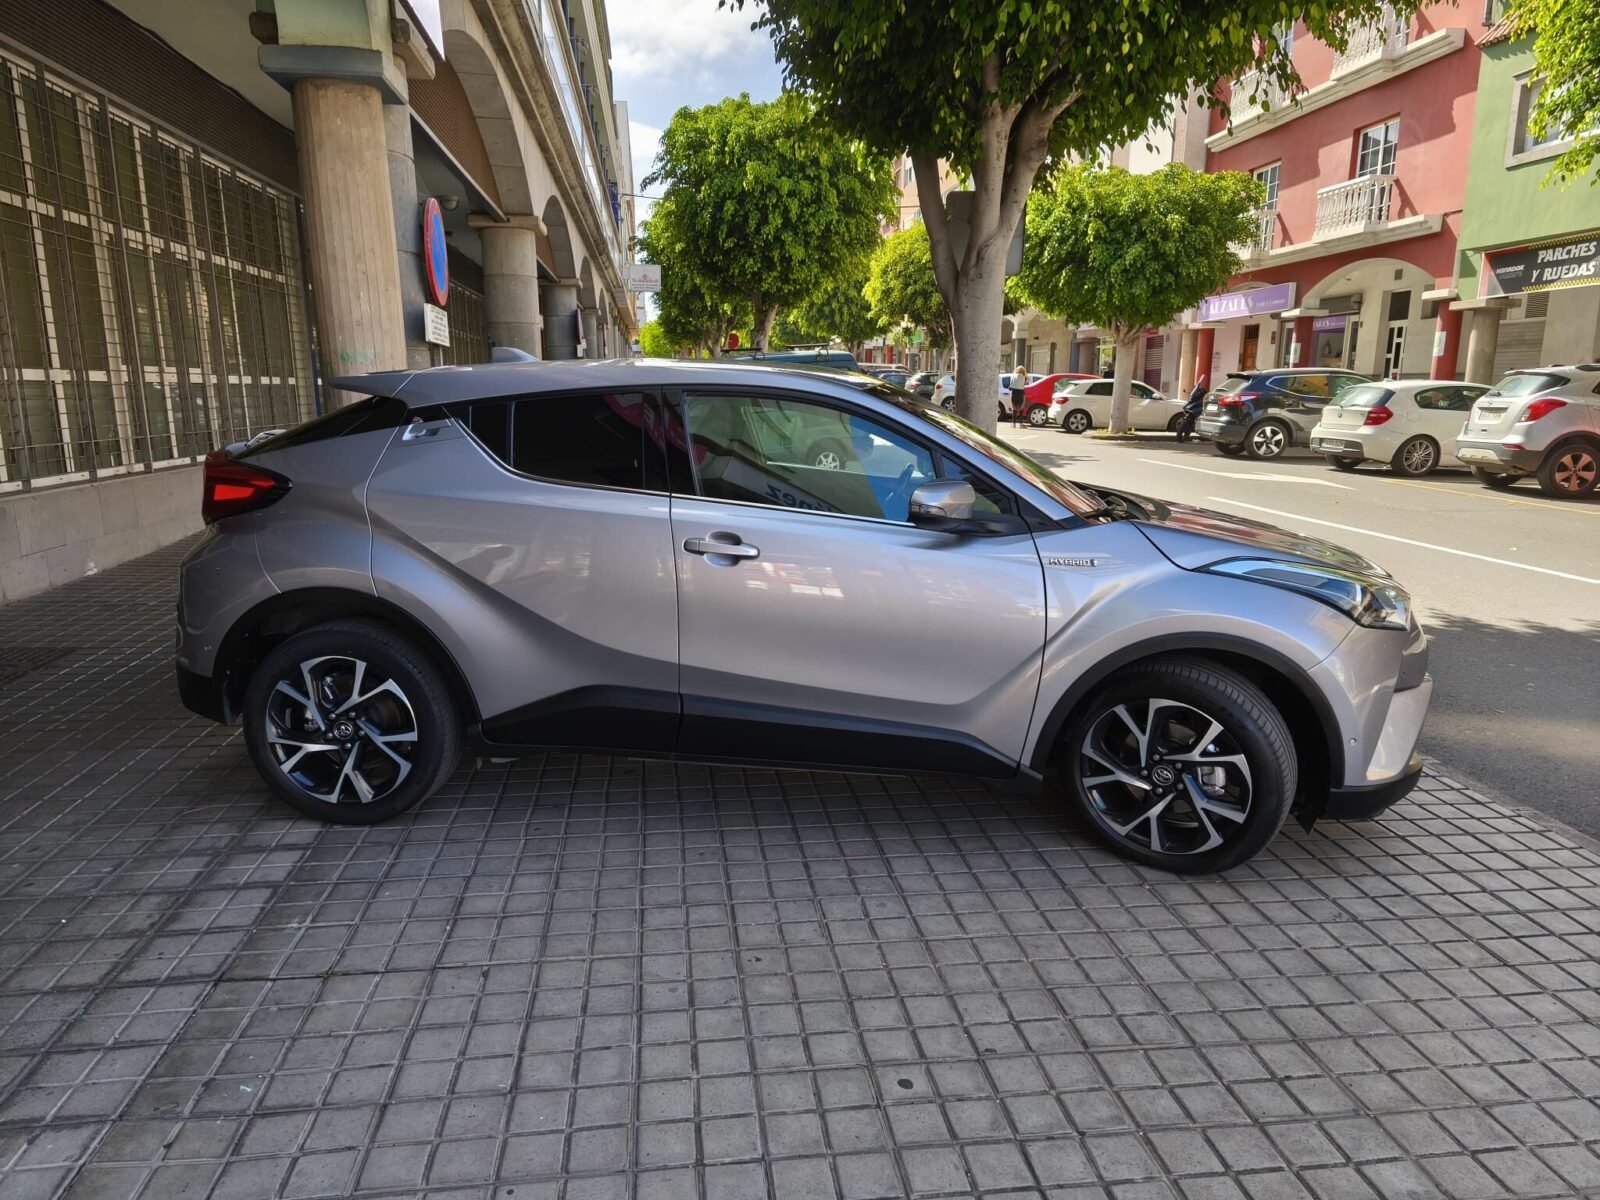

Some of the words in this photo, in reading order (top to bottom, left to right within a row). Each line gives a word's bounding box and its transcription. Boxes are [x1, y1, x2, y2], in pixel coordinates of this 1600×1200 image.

[1537, 241, 1598, 264] PARCHES
[1530, 269, 1541, 283] Y
[1542, 261, 1597, 282] RUEDAS
[1049, 557, 1091, 567] HYBRID
